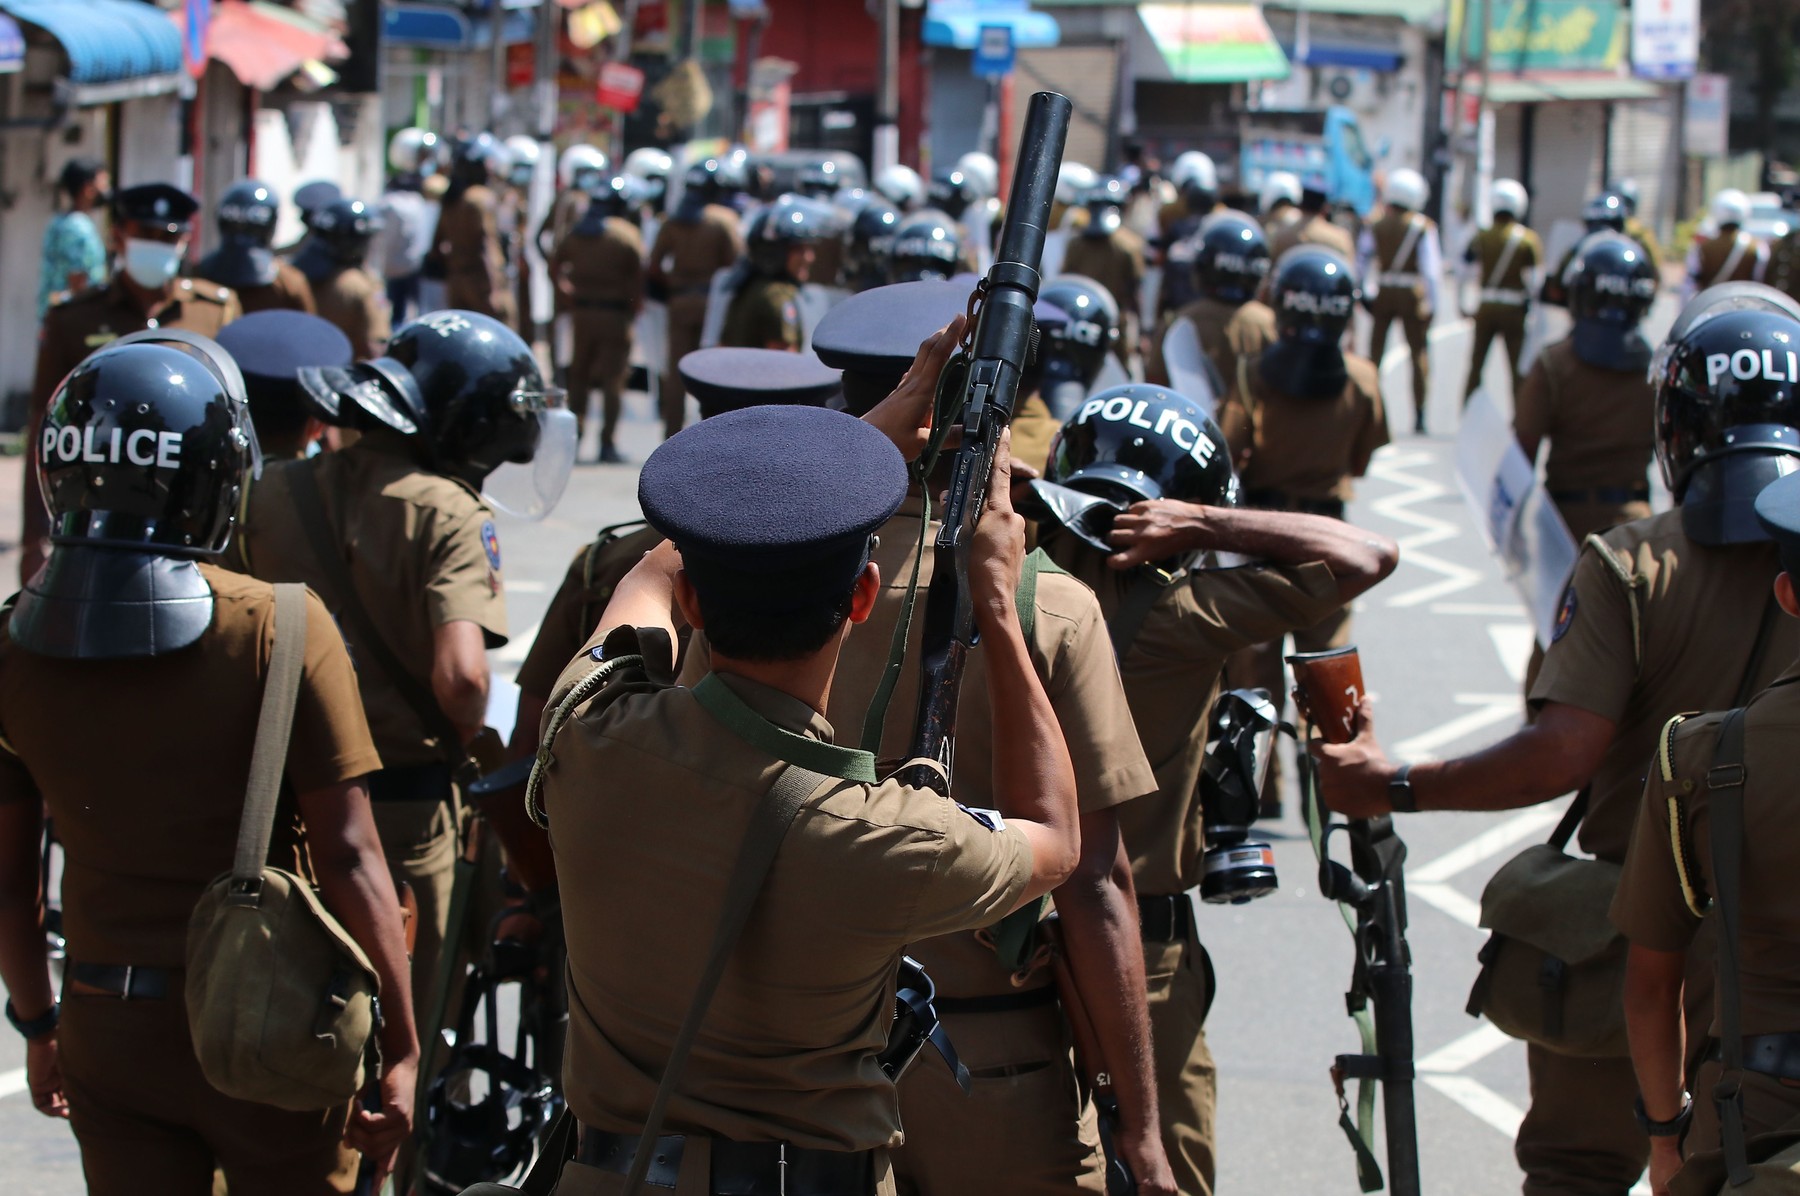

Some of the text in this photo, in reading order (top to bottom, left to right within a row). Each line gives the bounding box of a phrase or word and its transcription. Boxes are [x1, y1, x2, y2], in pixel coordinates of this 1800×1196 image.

[1283, 290, 1350, 315] POLICE
[1707, 349, 1798, 386] POLI
[43, 425, 183, 469] POLICE
[1078, 397, 1216, 469] POLICE
